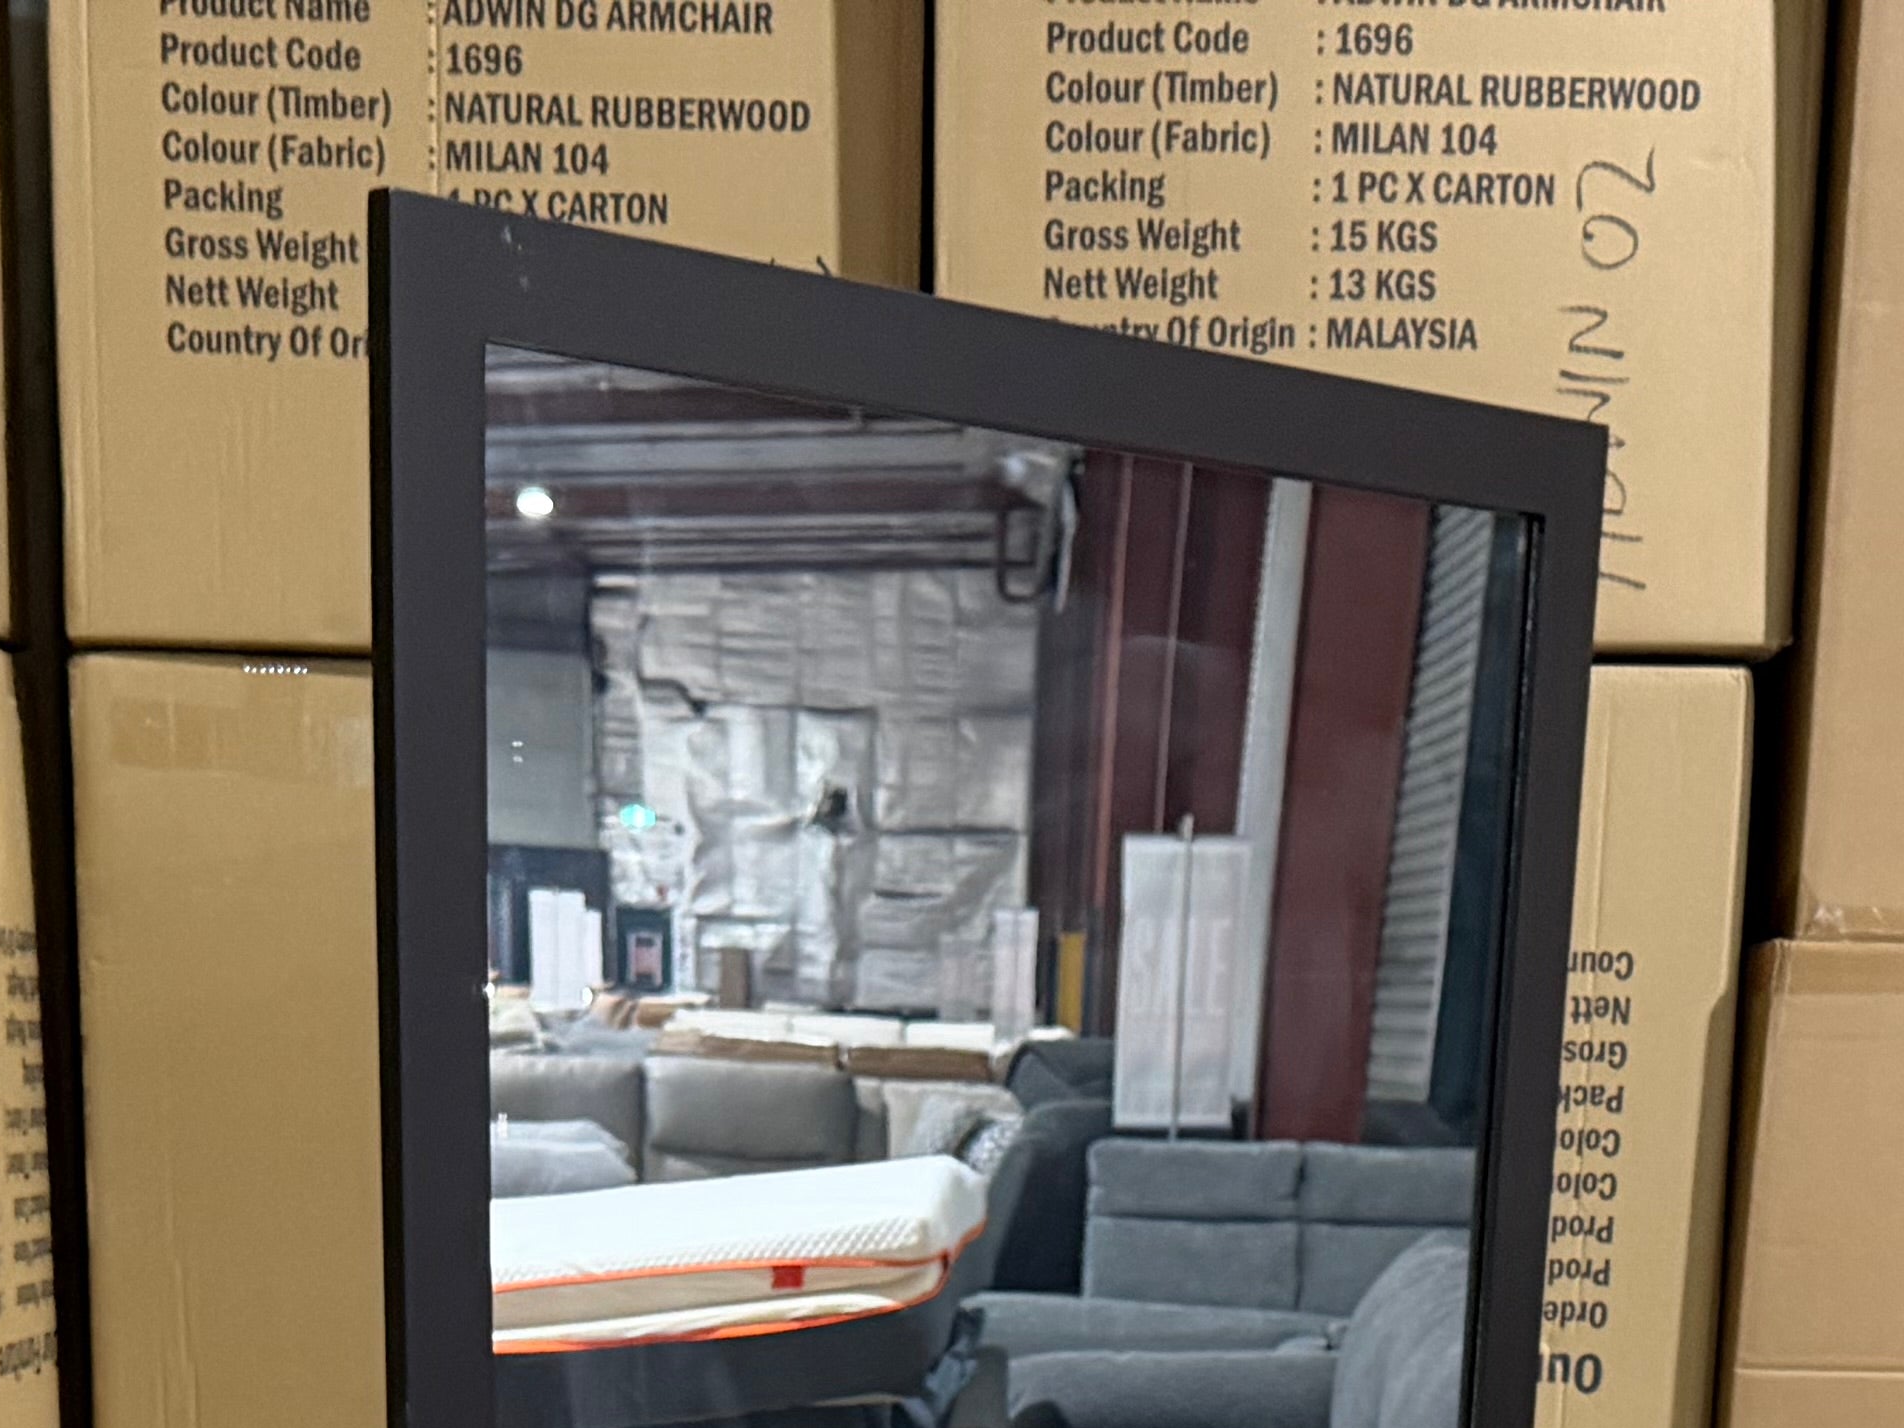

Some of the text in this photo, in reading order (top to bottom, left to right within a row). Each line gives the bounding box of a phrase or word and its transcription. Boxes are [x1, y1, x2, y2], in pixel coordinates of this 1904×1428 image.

[442, 0, 773, 35] ADWIN DG ARMCHAIR
[1046, 20, 1414, 57] Product Code 1696
[160, 31, 523, 77] Product Code 1696
[161, 80, 811, 133] Colour (Timber) NATURAL RUBBERWOOD
[1045, 69, 1701, 113] Colour (Timber) NATURAL RUBBERWOOD
[161, 129, 609, 177] Colour (Fabric) MILAN 104
[1045, 118, 1498, 161] Colour (Fabric) MILAN 104
[163, 177, 284, 221] Packing
[547, 190, 668, 225] CARTON
[1045, 168, 1555, 210] Packing 1 PC X CARTON
[164, 226, 359, 271] Gross Weight
[1043, 217, 1438, 259] Gross Weight 15 KGS
[165, 273, 339, 318] Nett Weight
[1043, 266, 1437, 307] Nett Weight 13 KGS
[166, 320, 282, 363] Country
[1166, 314, 1201, 348] Of
[1207, 315, 1296, 356] Origin
[1326, 316, 1478, 351] MALAYSIA
[1570, 996, 1631, 1026] Nett
[1562, 1040, 1628, 1070] Gros
[1560, 1128, 1621, 1158] Colo
[1557, 1172, 1618, 1201] Colo
[1551, 1215, 1615, 1244] Prod
[1548, 1258, 1612, 1286] Prod
[1543, 1300, 1609, 1329] Orde
